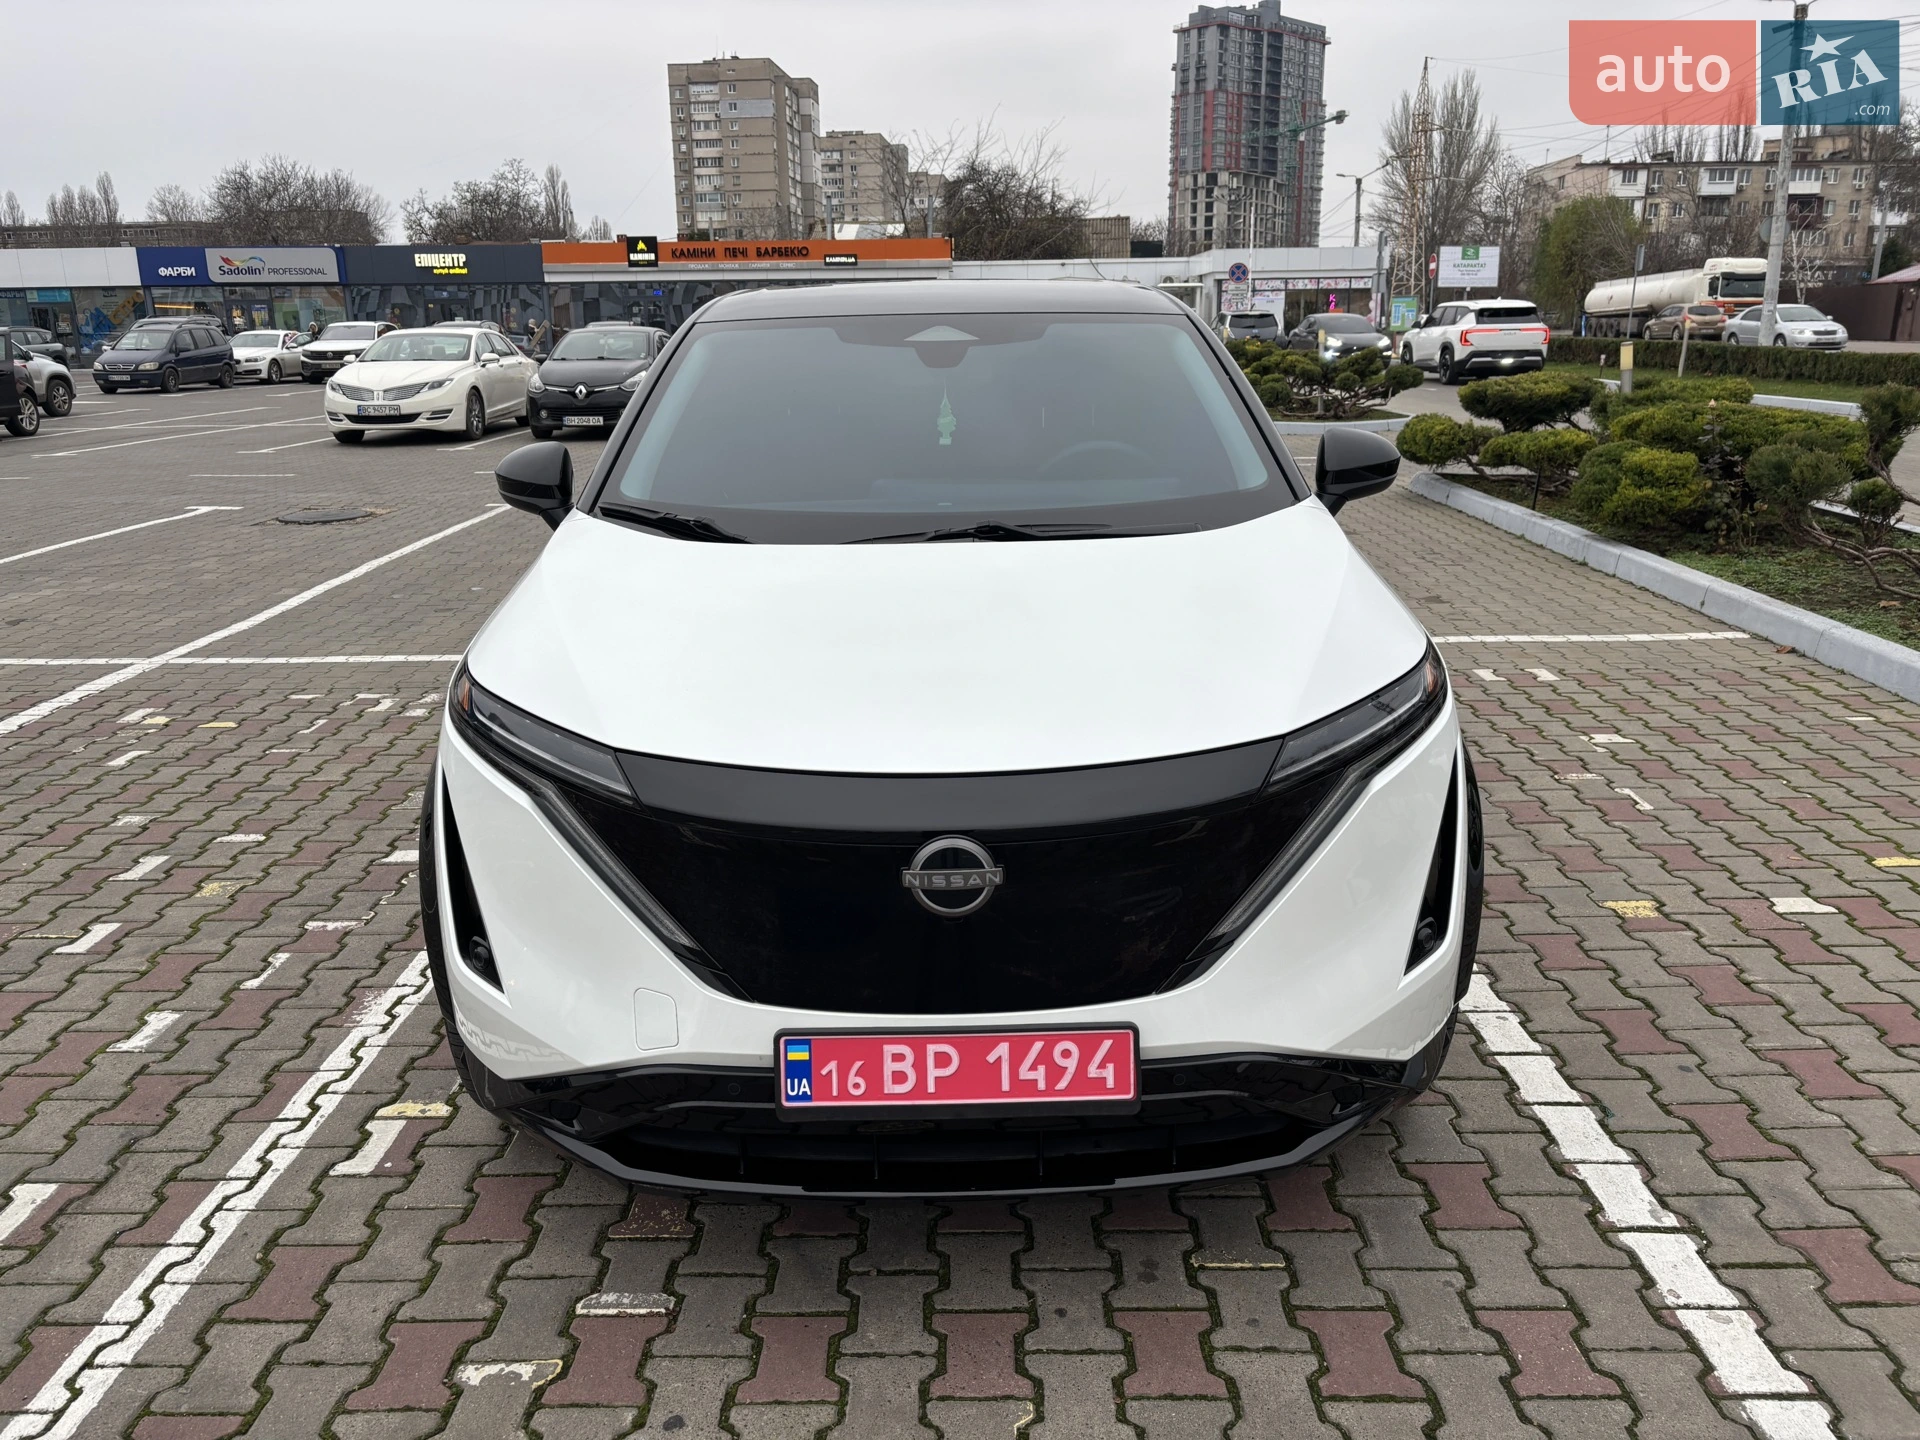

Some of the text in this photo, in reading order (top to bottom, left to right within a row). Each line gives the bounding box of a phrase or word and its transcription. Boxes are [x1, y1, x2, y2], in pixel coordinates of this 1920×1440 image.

[671, 246, 810, 259] КАМІНИ ПЕЧІ БАРБЕКЮ
[414, 253, 467, 267] ЕПІЦЕНТР
[158, 266, 196, 277] ФАРБИ
[218, 265, 328, 276] Sadolin PROFESSIONAL
[905, 871, 1001, 888] NISSAN
[820, 1039, 1115, 1097] 16 BP 1494
[786, 1078, 811, 1096] UA
